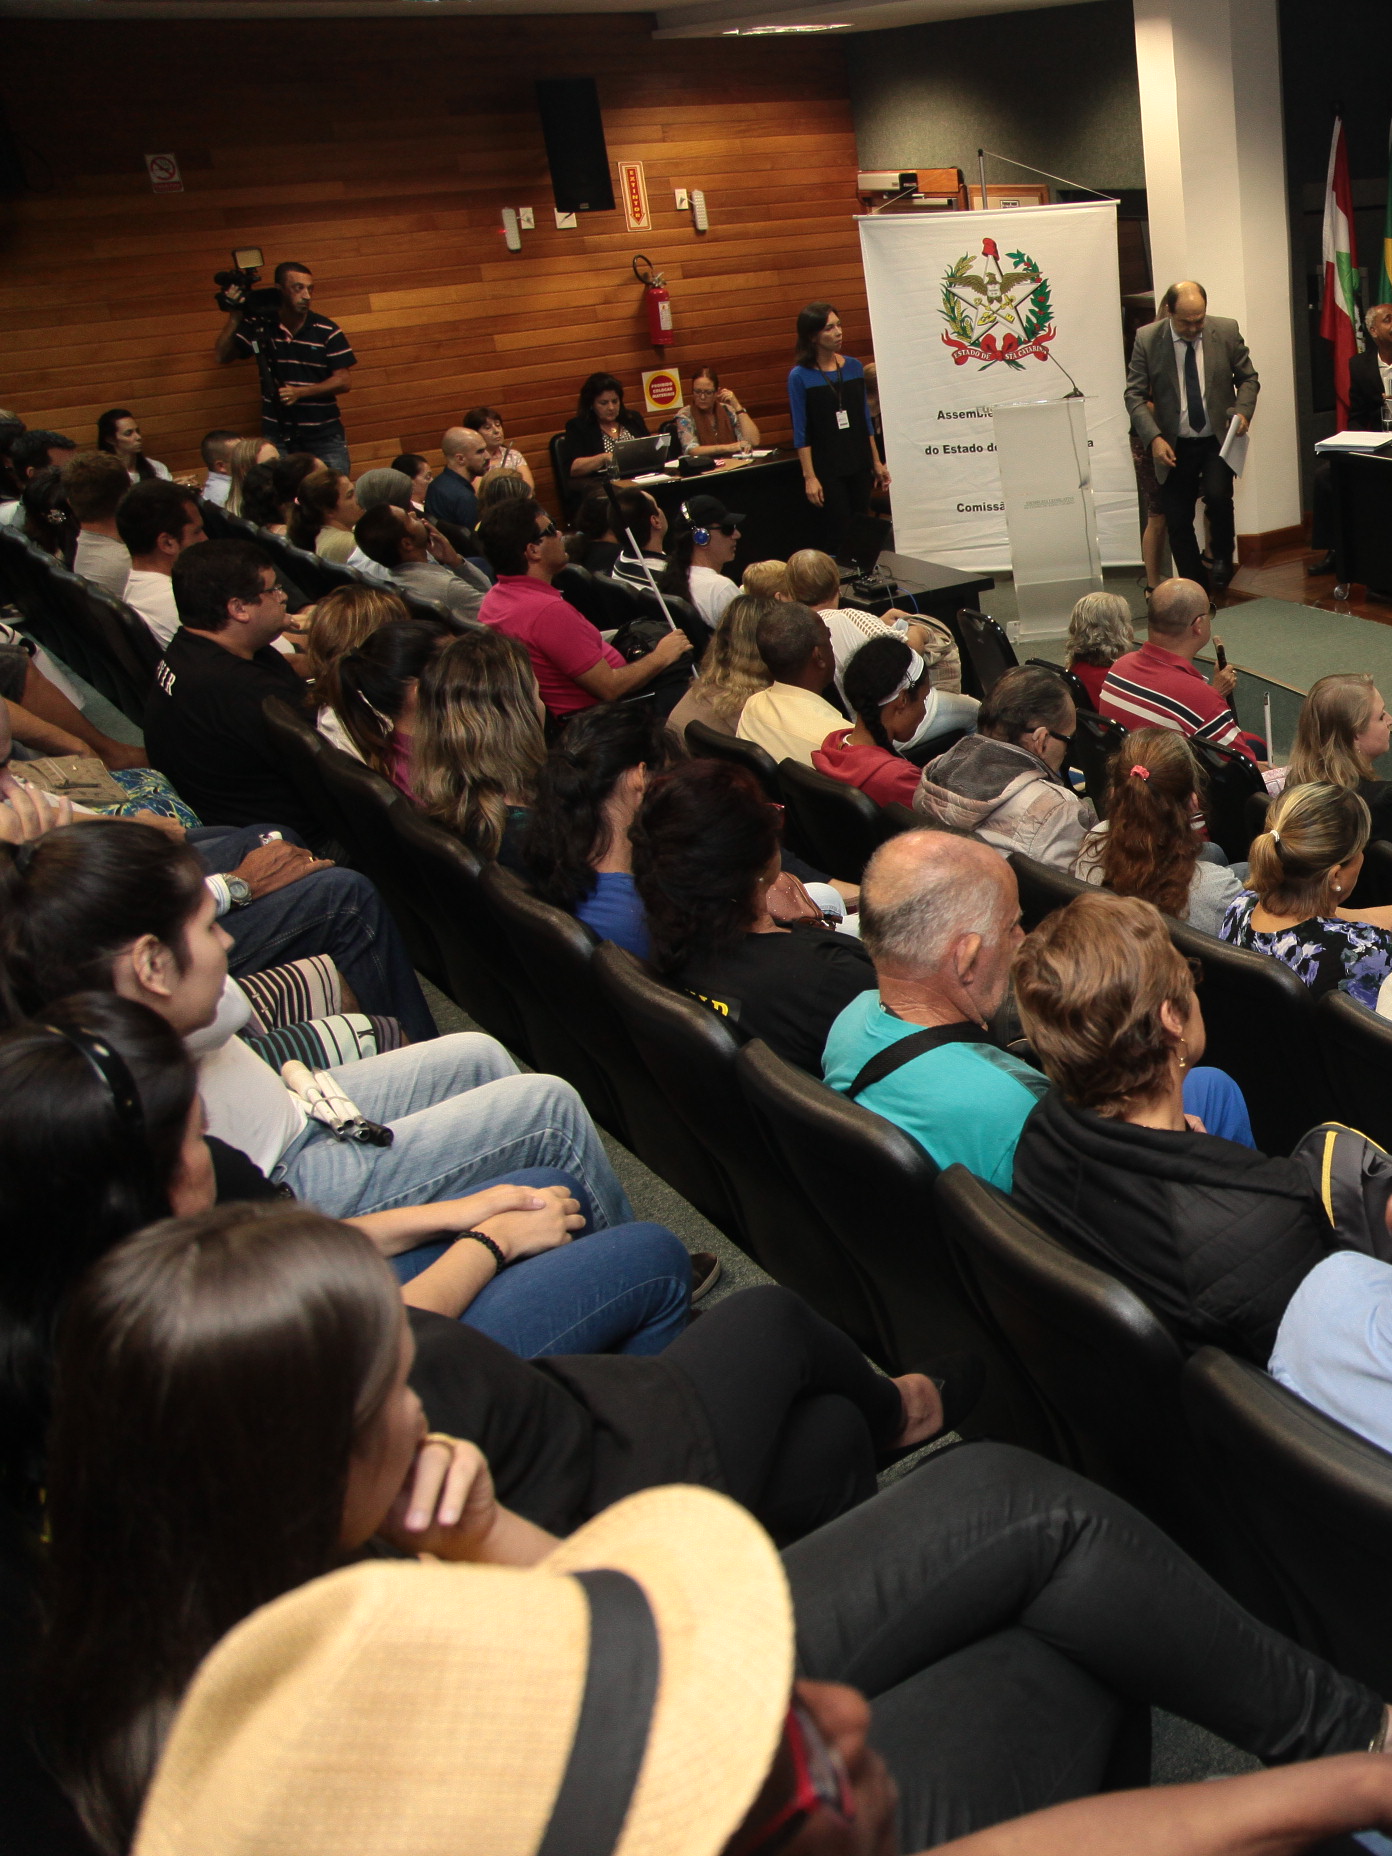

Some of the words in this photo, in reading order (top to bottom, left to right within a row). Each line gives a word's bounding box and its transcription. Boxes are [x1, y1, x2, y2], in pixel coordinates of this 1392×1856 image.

[629, 170, 641, 218] EXTINTOR
[953, 348, 980, 359] ESTADO
[981, 351, 991, 360] DE
[1005, 352, 1018, 360] STA
[925, 445, 939, 456] do
[943, 443, 983, 455] Estado
